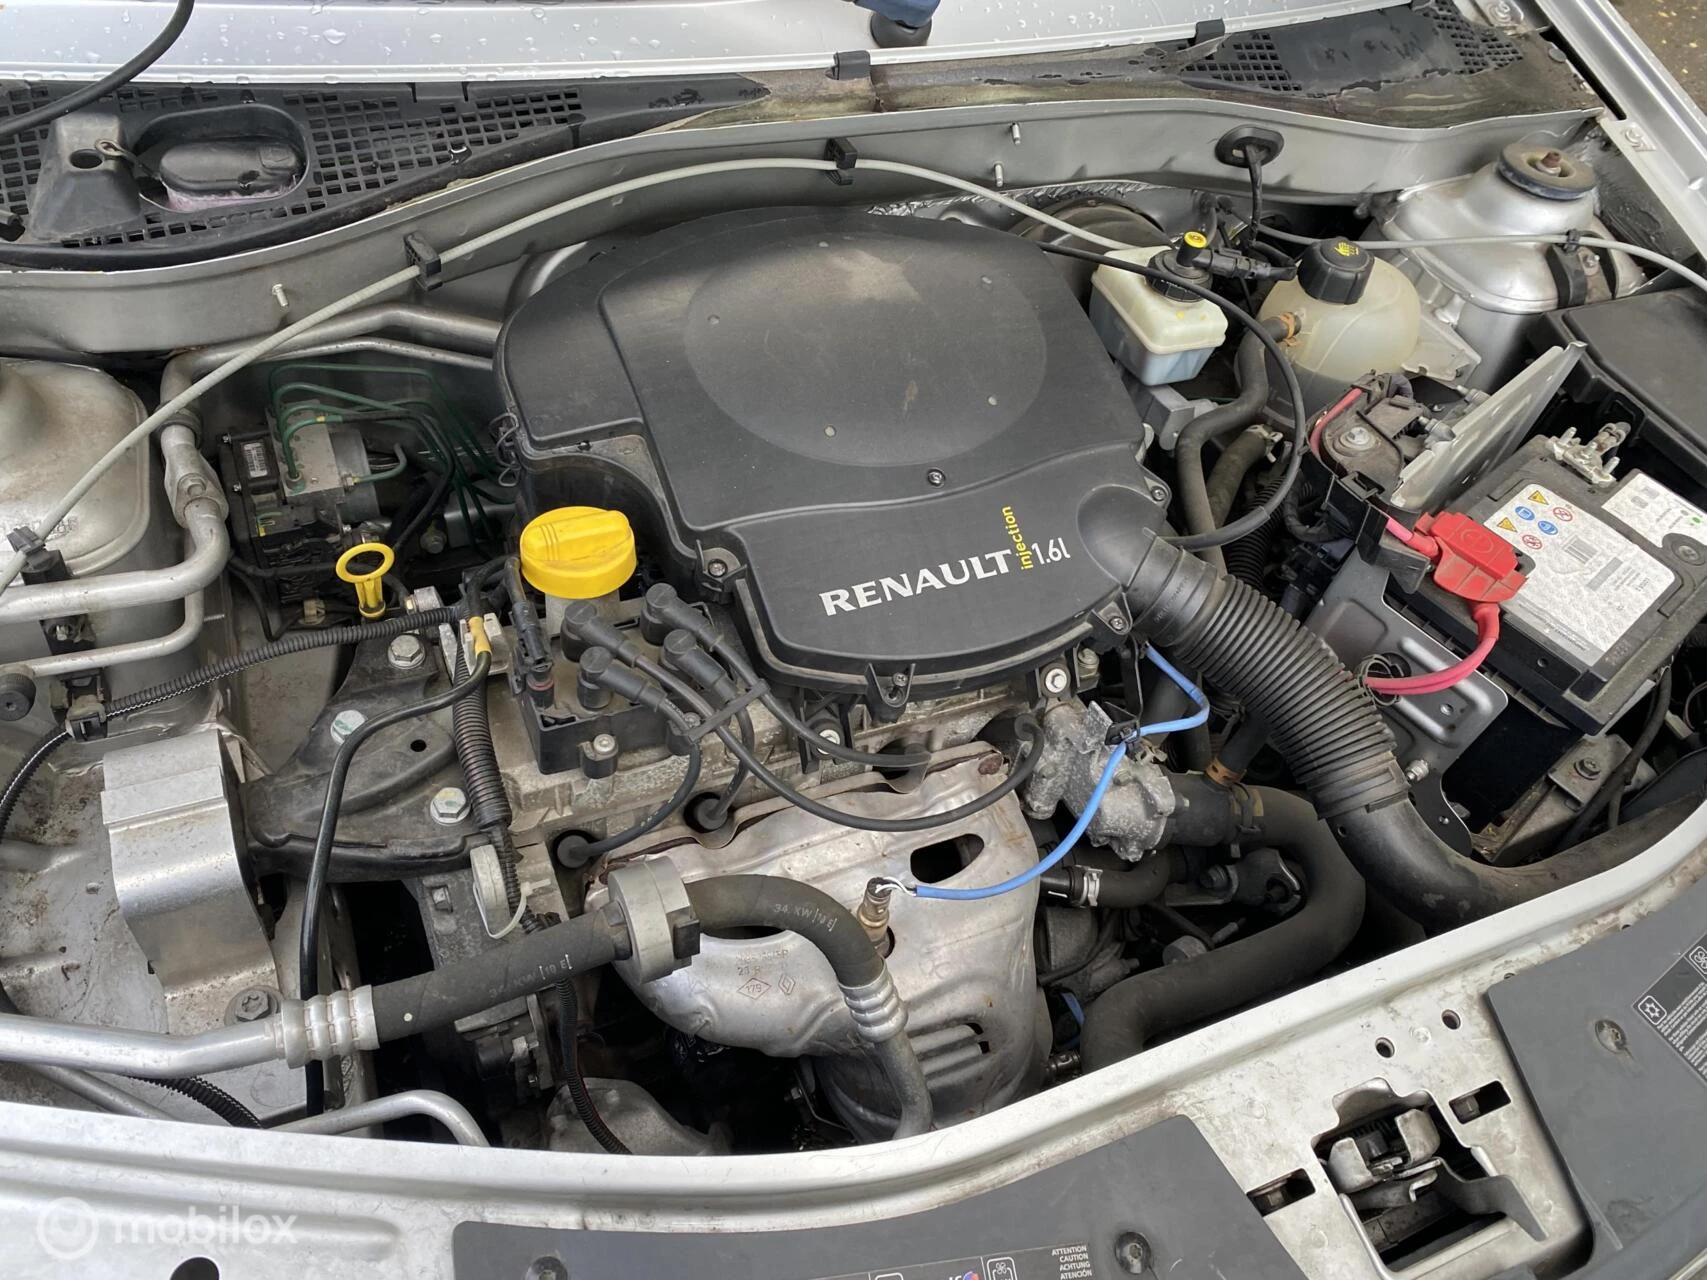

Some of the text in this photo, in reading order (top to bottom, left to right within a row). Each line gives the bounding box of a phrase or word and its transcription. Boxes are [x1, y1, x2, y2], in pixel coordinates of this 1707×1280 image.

[1002, 506, 1033, 570] injection
[819, 549, 1012, 616] RENAULT
[1051, 1245, 1087, 1256] ATTENTION
[1059, 1253, 1089, 1263] CAUTION
[1059, 1261, 1091, 1271] ACHTUNG
